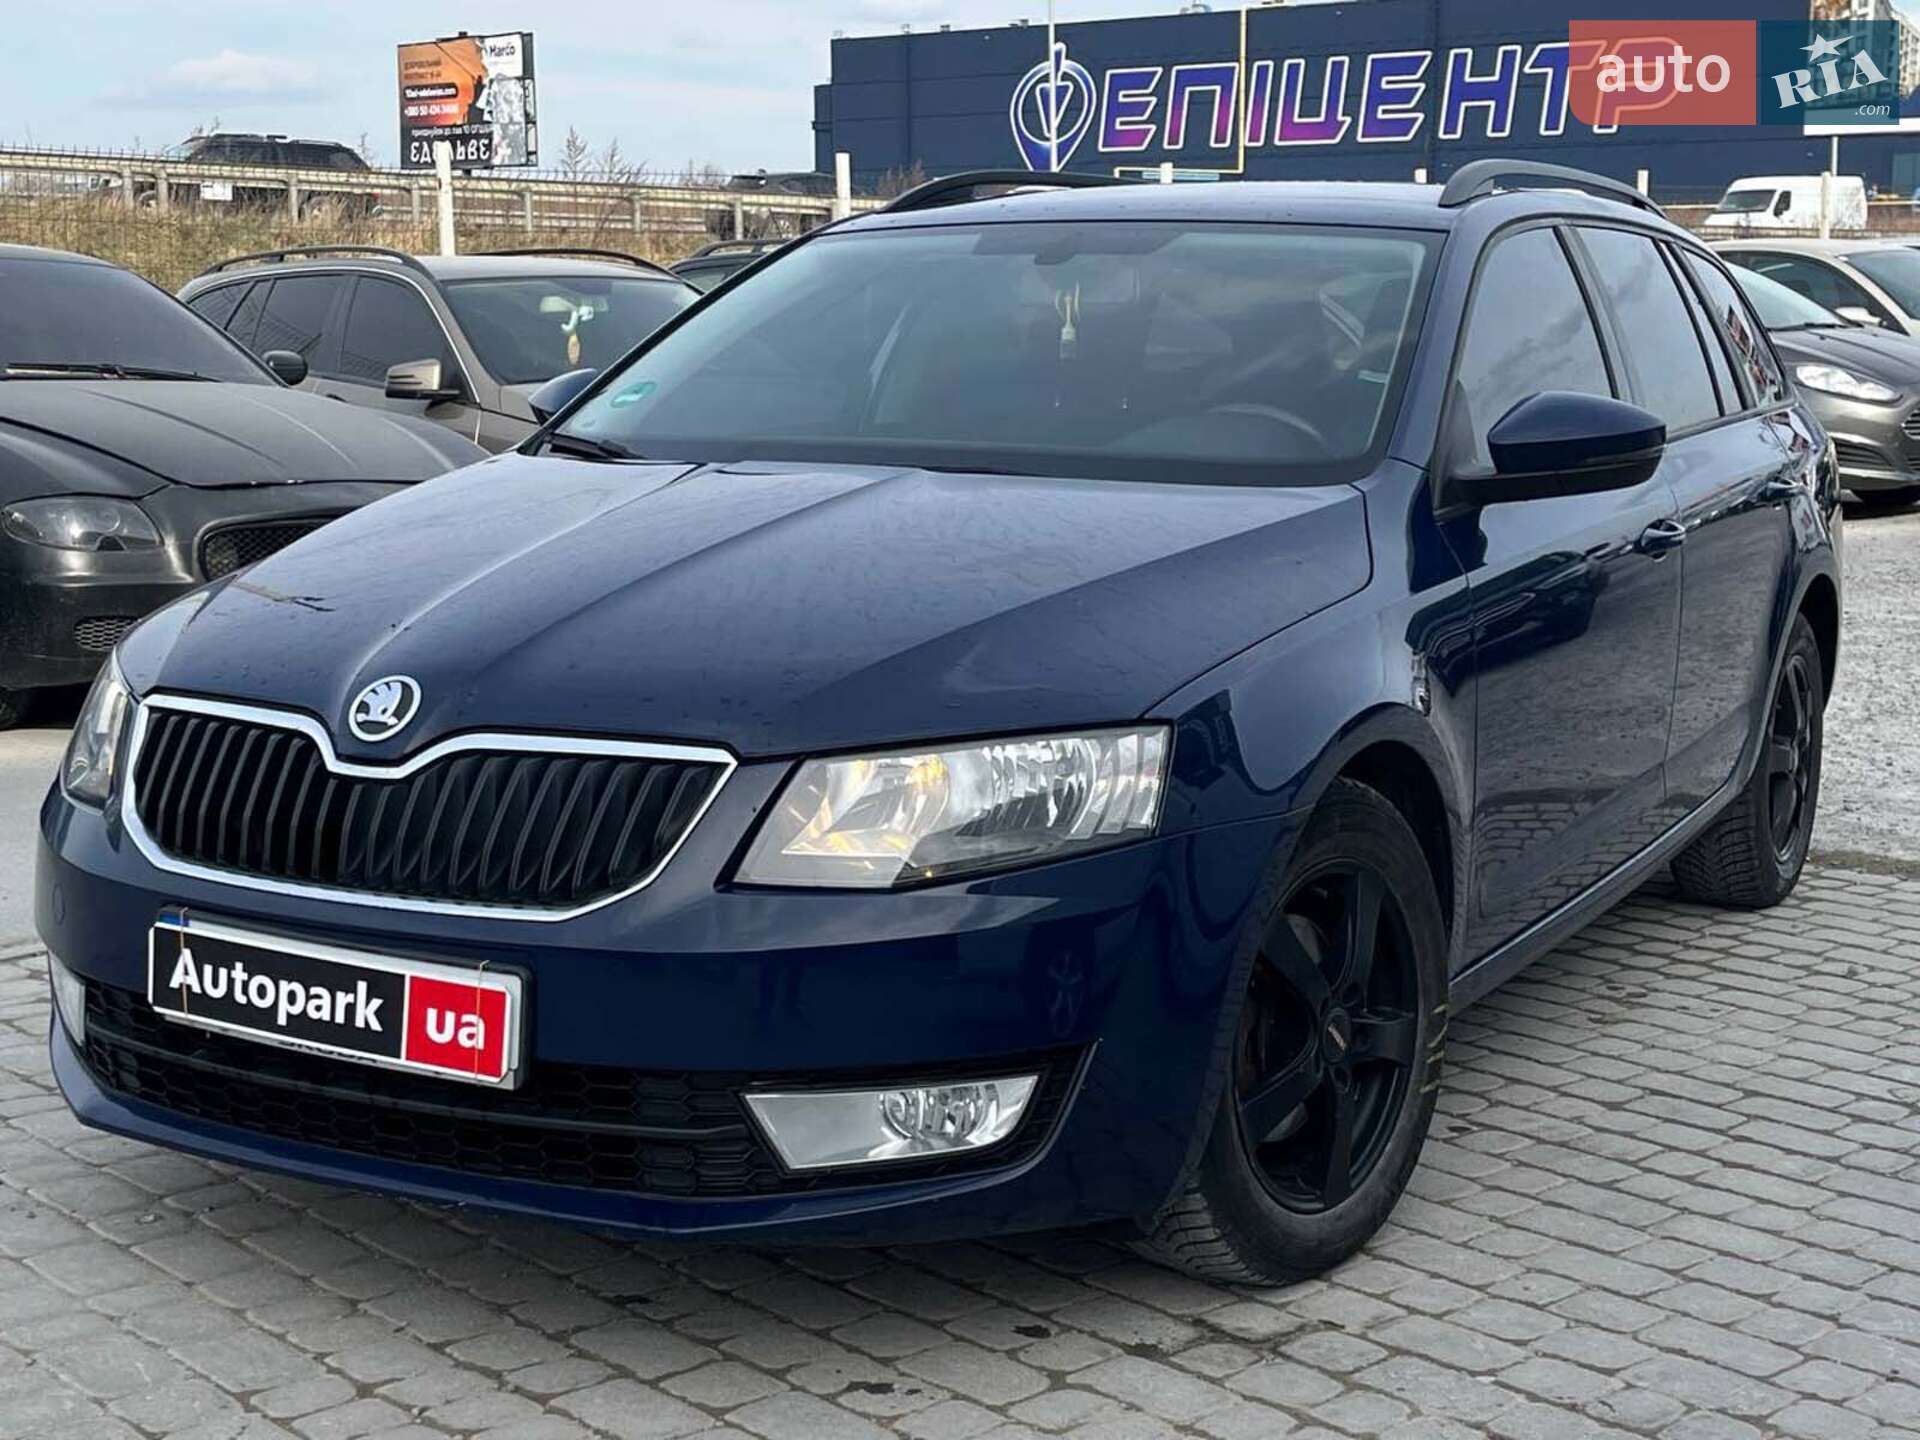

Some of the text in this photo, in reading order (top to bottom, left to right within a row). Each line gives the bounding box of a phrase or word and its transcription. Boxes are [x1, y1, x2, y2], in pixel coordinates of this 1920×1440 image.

[1098, 37, 1683, 153] ЕПІЦЕНТР
[169, 948, 485, 1051] Autopark ua
